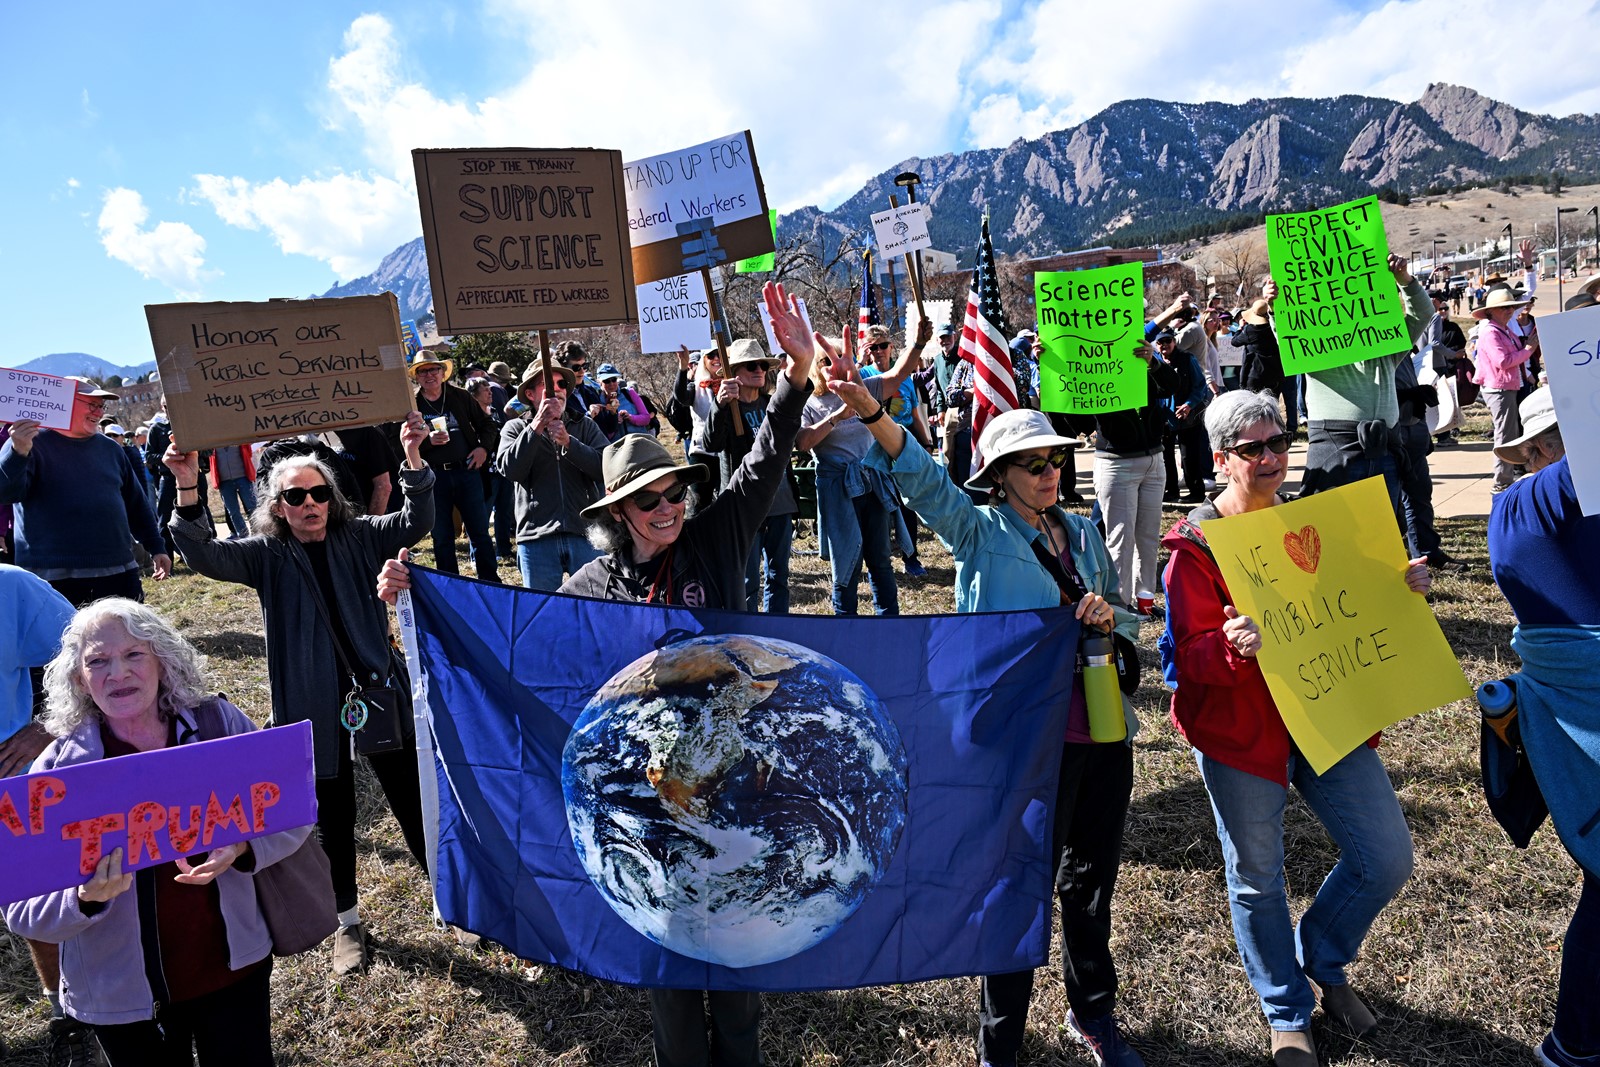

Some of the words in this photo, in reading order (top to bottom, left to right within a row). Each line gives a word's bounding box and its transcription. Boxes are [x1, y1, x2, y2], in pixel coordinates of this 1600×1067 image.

[462, 160, 496, 174] STOP
[500, 160, 523, 172] THE
[527, 158, 576, 172] TYRANNY
[622, 159, 674, 191] TAND
[679, 153, 702, 181] UP
[709, 139, 747, 173] FOR
[458, 183, 594, 224] SUPPORT
[626, 202, 673, 231] ederal
[680, 193, 747, 220] Workers
[874, 216, 890, 226] MAKE
[1275, 201, 1373, 239] RESPECT
[473, 233, 604, 274] SCIENCE
[884, 237, 909, 251] SMART
[1284, 247, 1380, 282] SERVICE
[654, 275, 689, 292] SAVE
[663, 287, 689, 302] OUR
[1039, 276, 1136, 303] Science
[1282, 270, 1377, 307] REJECT
[455, 288, 529, 306] APPRECIATE
[532, 288, 558, 305] FED
[560, 287, 610, 301] WORKERS
[642, 301, 709, 324] SCIENTISTS
[1279, 293, 1390, 331] "UNCIVIL"
[1078, 342, 1115, 359] NOT
[8, 371, 39, 383] STOP
[41, 376, 63, 388] THE
[15, 385, 51, 398] STEAL
[1058, 374, 1117, 395] Science
[0, 395, 15, 404] OF
[17, 397, 67, 412] FEDERAL
[204, 392, 246, 412] they
[331, 379, 373, 399] ALL
[1072, 395, 1122, 410] Fiction
[15, 409, 48, 421] JOBS!
[1234, 545, 1279, 589] WE
[1262, 589, 1358, 645] PUBLIC
[1297, 627, 1398, 701] SERVICE
[60, 781, 281, 876] TRUMP
